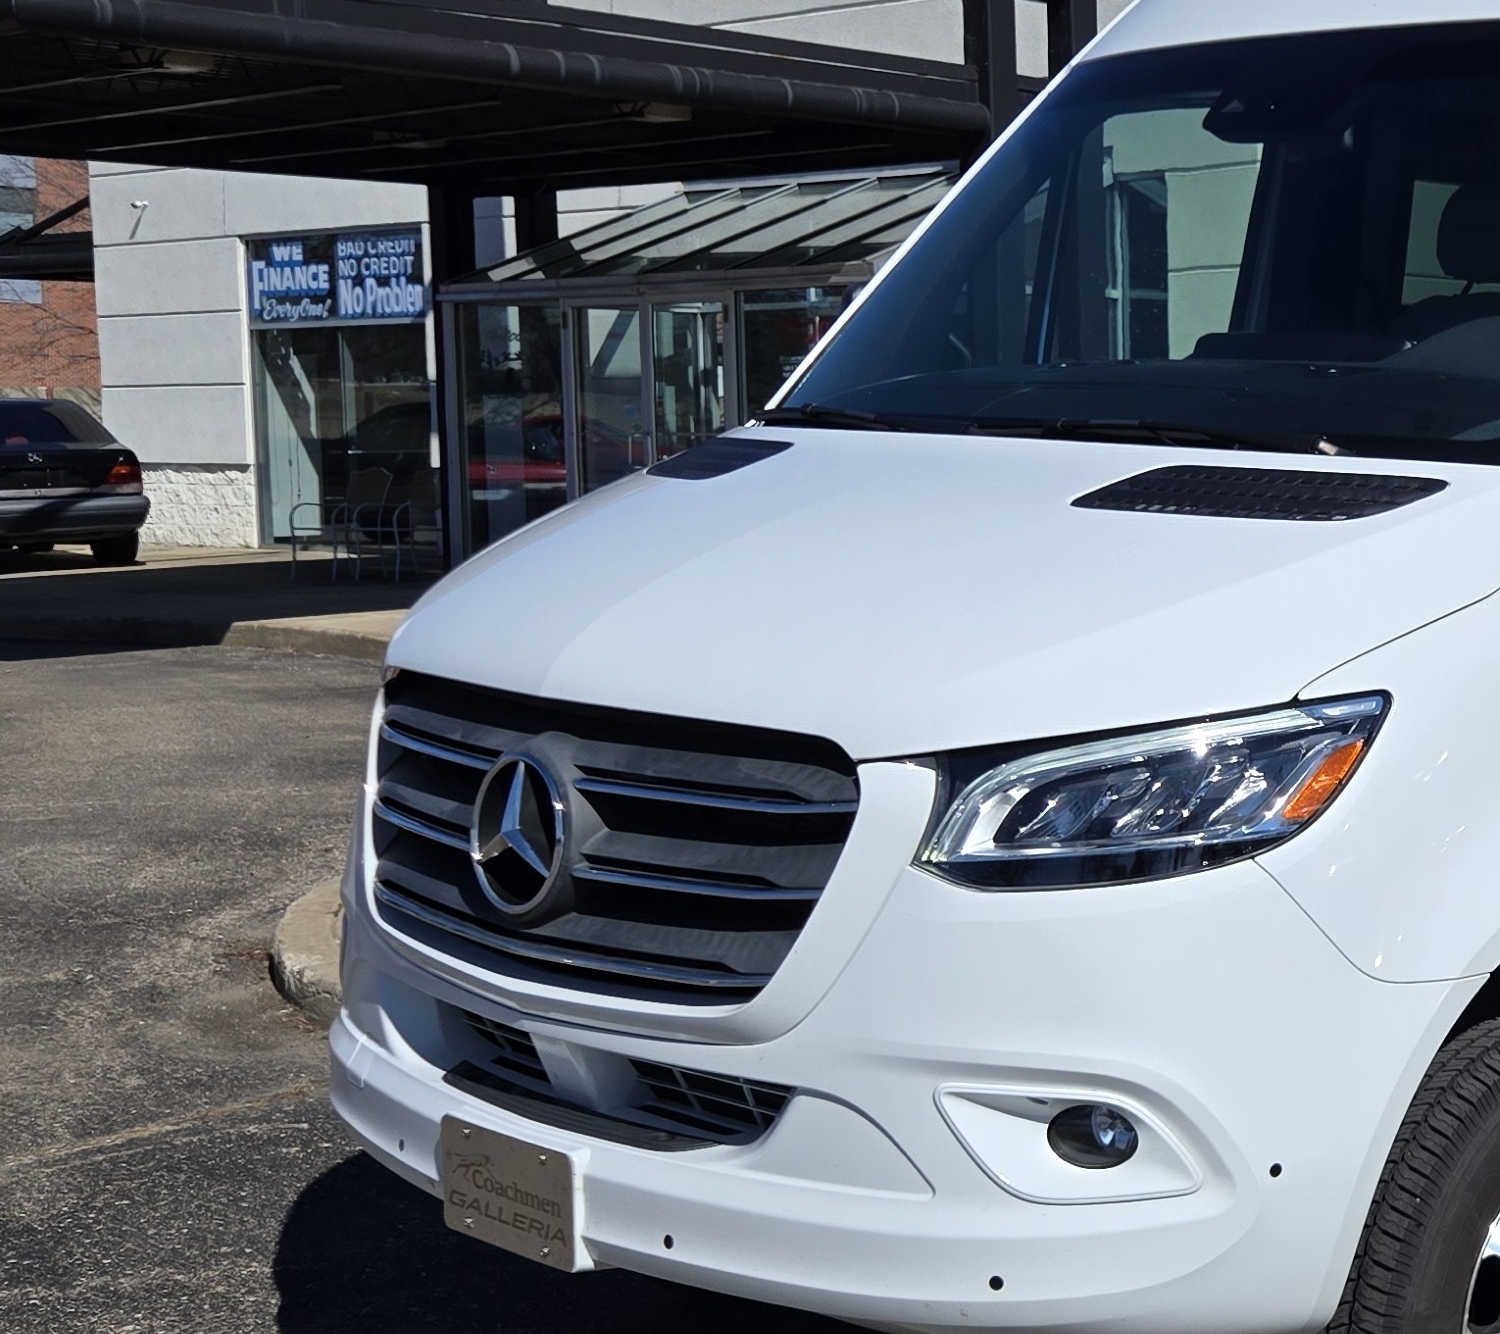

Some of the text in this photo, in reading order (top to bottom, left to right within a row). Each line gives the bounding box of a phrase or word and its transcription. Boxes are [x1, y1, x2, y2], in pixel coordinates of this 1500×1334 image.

[272, 242, 303, 262] WE
[338, 255, 414, 277] NO CREDIT
[252, 261, 330, 310] FINANCE
[338, 278, 364, 315] No
[471, 1169, 562, 1219] Coachmen
[449, 1189, 567, 1248] GALLERIA
